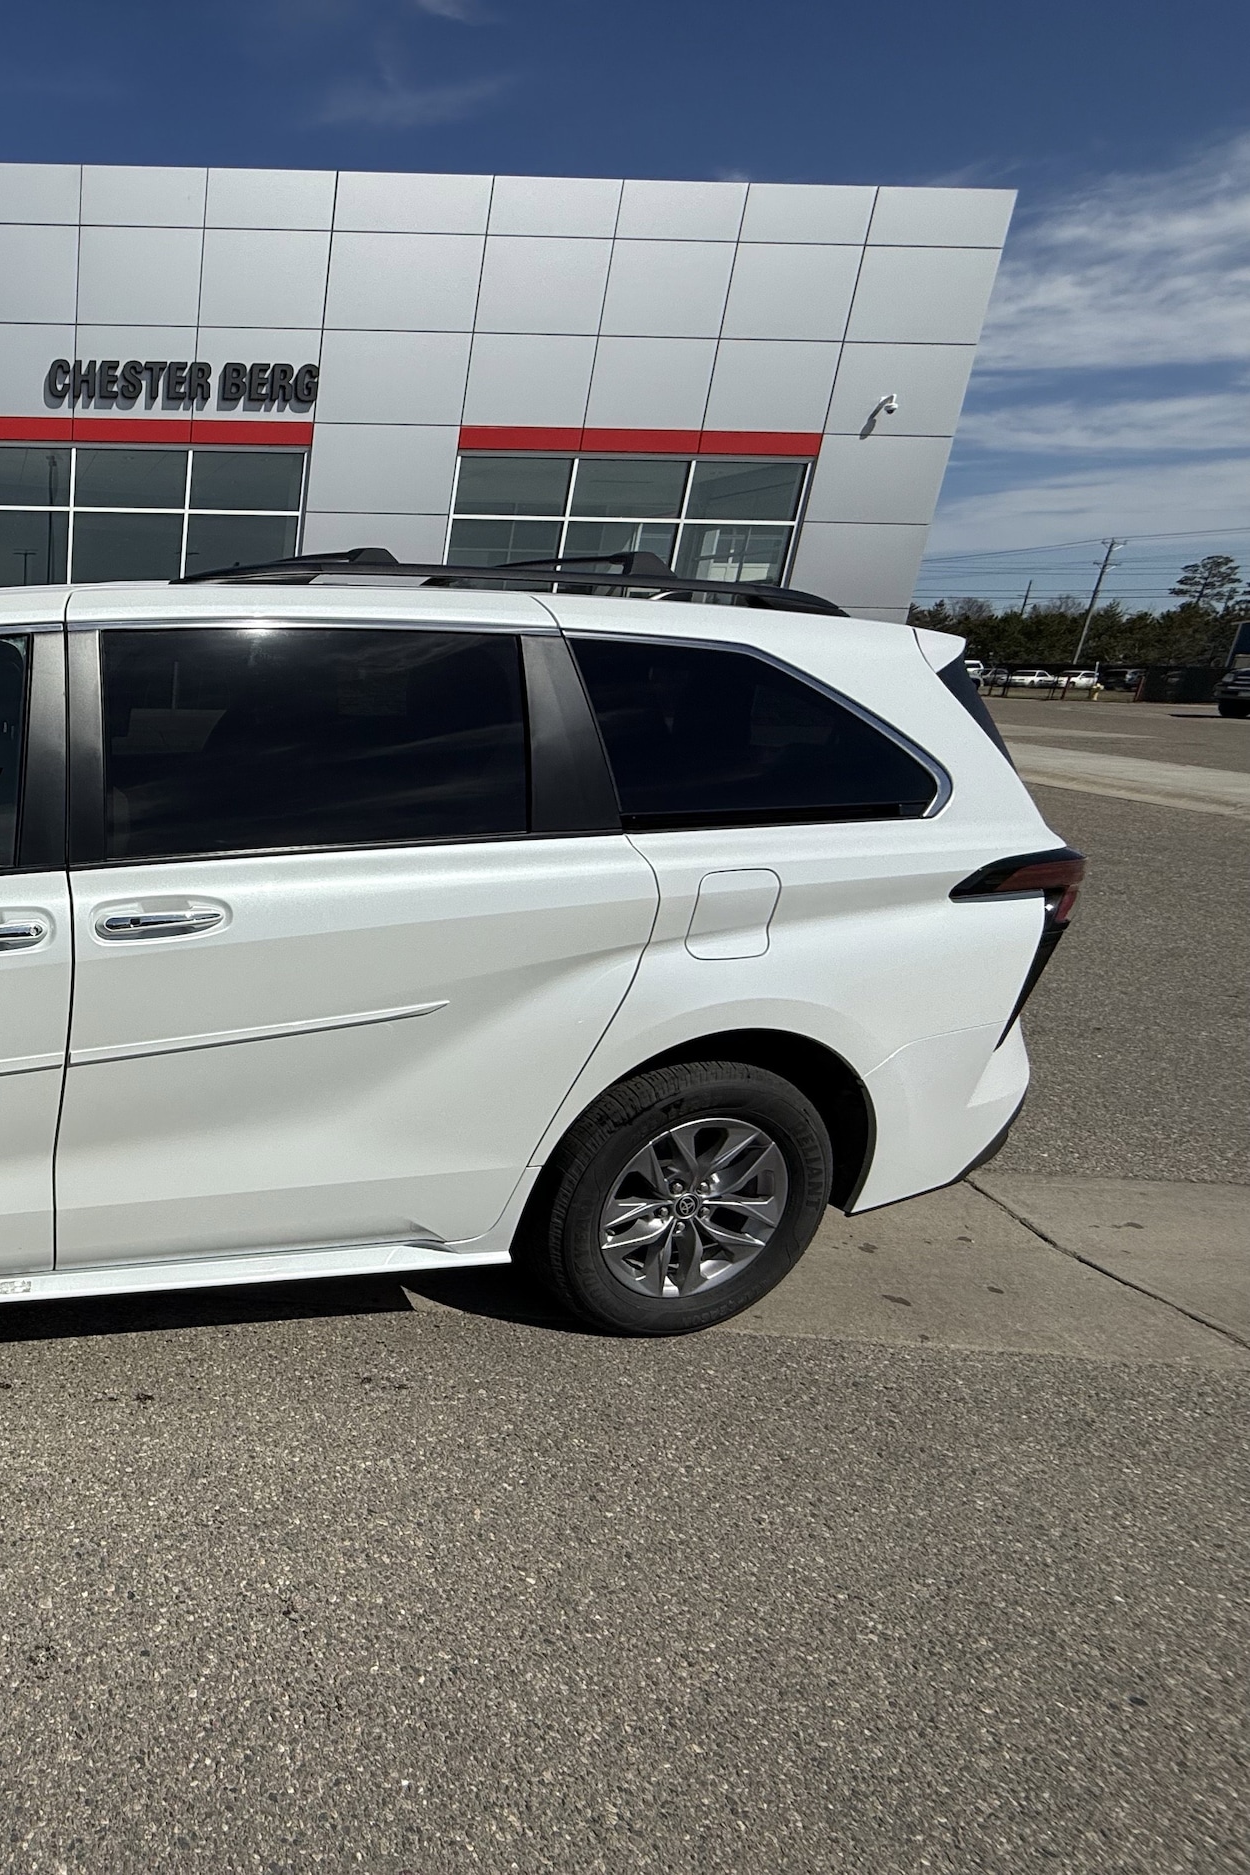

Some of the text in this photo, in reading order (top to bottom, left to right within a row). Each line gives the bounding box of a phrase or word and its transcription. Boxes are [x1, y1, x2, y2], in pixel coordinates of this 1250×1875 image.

[49, 358, 320, 402] CHESTER BERG
[789, 1121, 824, 1211] RELIANT
